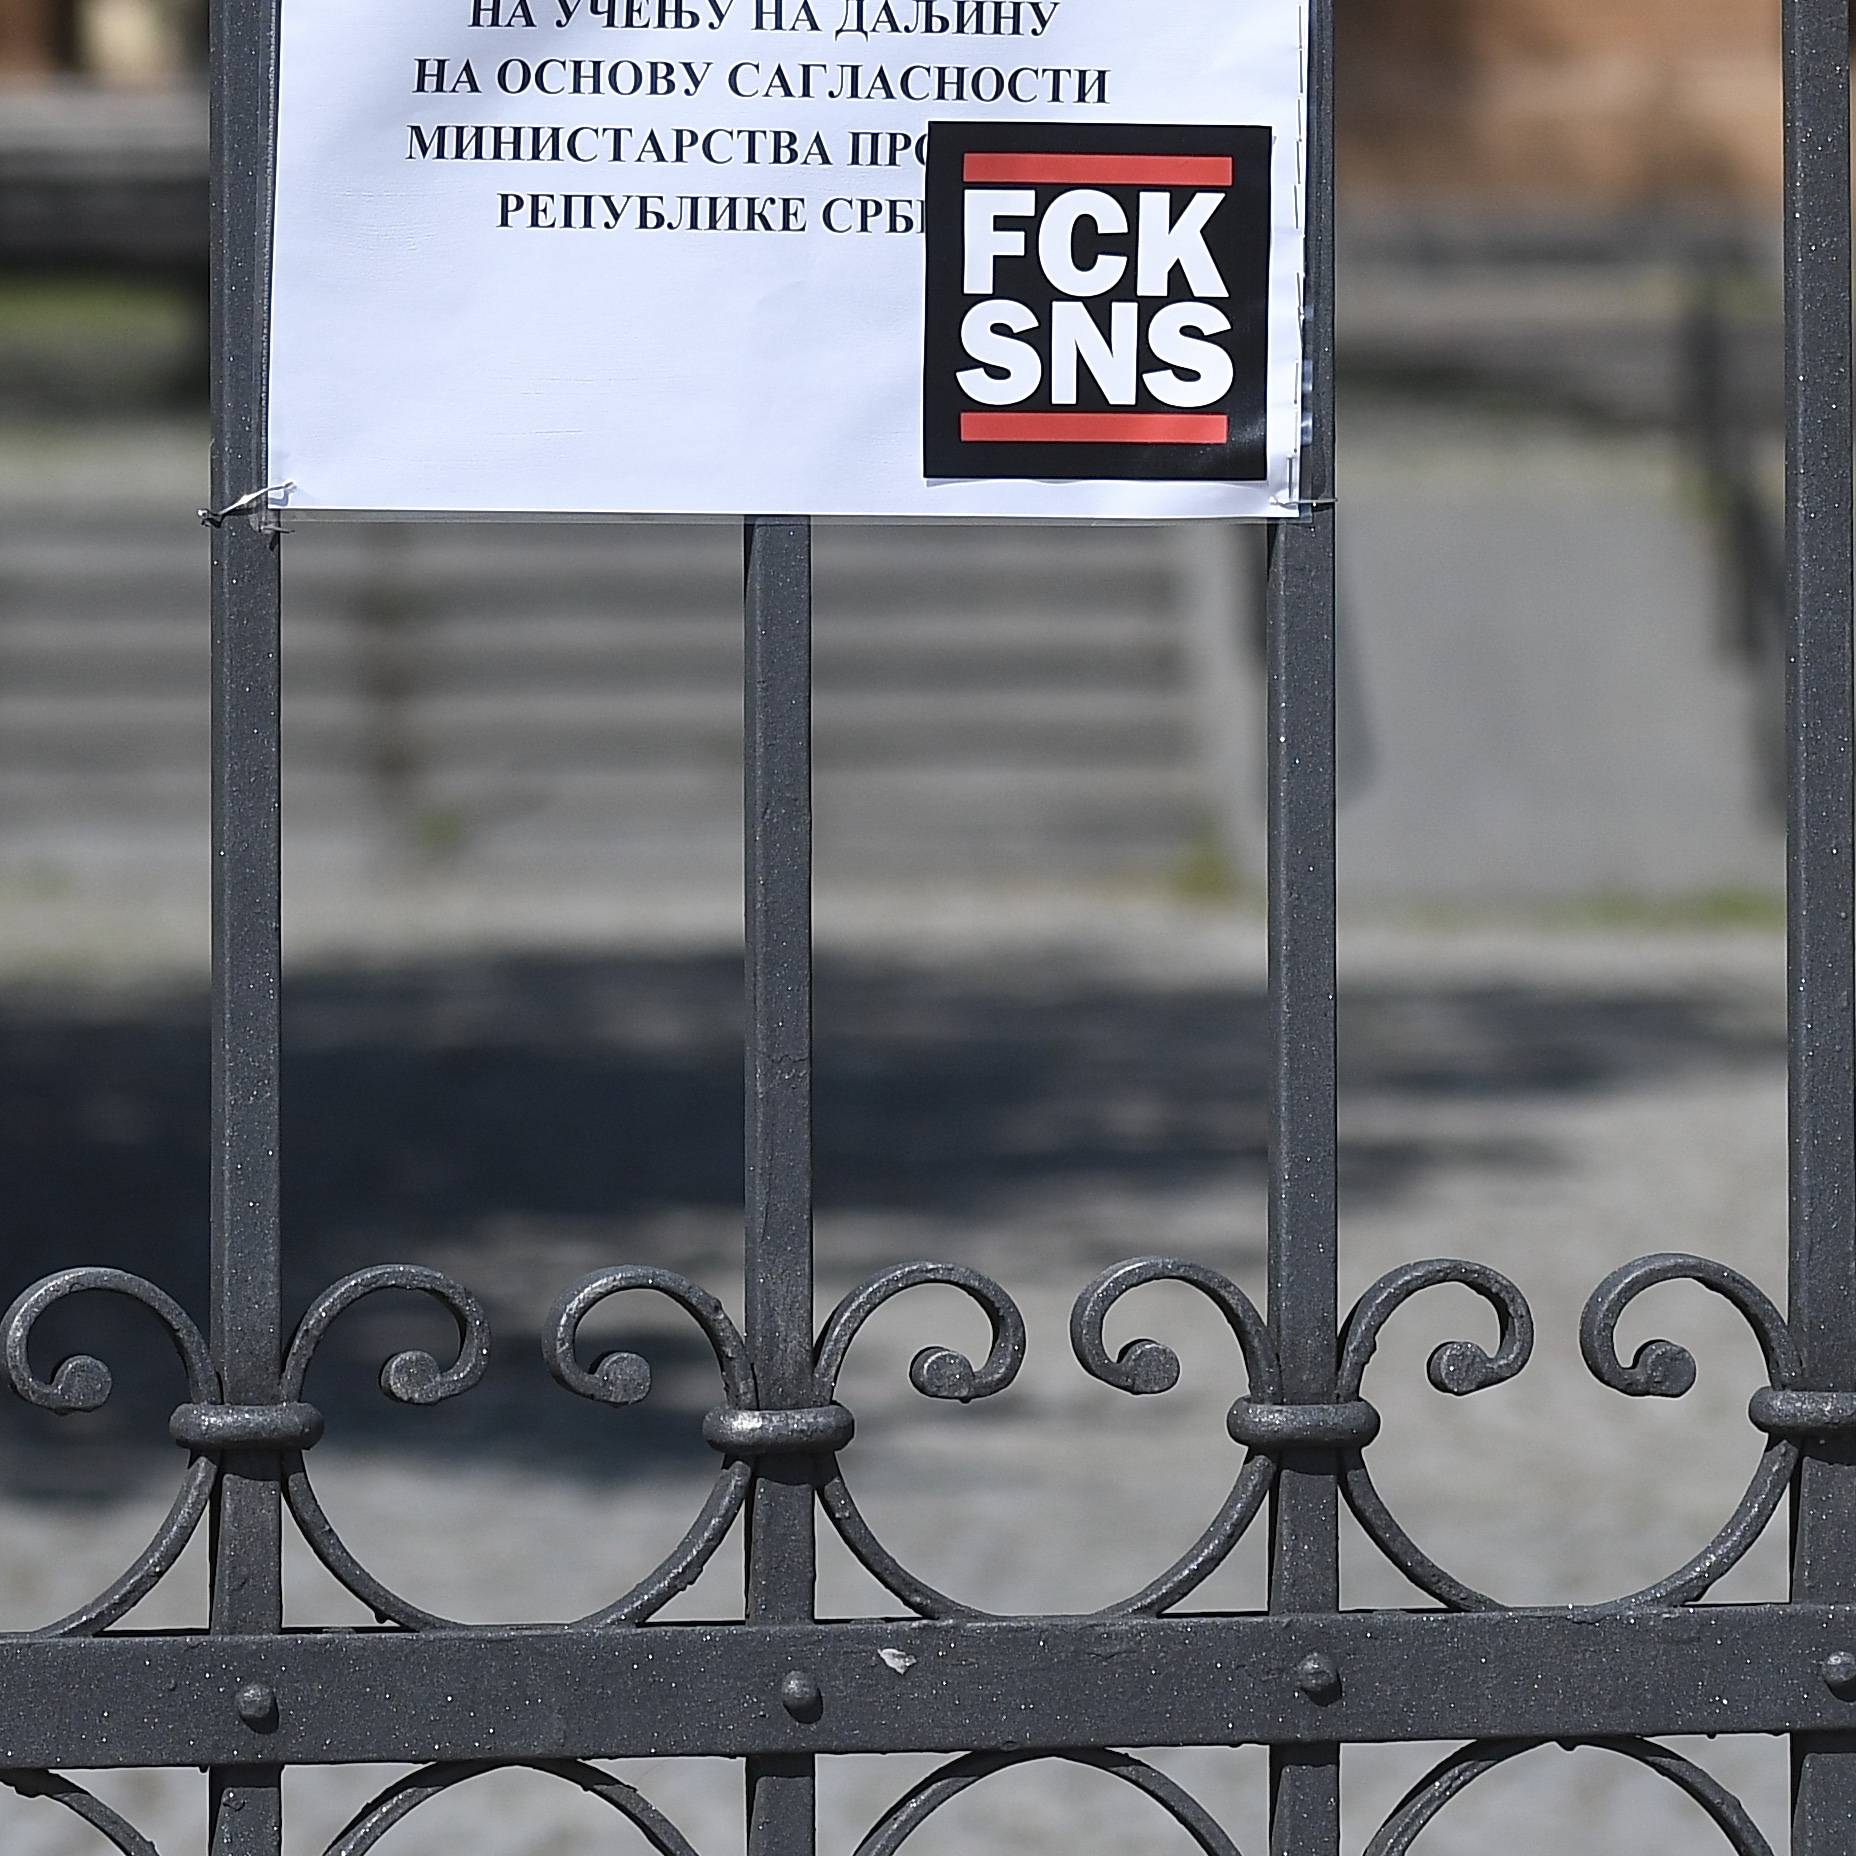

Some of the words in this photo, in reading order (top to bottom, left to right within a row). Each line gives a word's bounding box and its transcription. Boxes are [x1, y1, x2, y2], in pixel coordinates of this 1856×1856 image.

[412, 58, 482, 94] НА
[497, 58, 713, 97] ОСНОВУ
[727, 62, 1111, 104] САГЛАСНОСТИ
[405, 125, 833, 166] МИНИСТАРСТВА
[496, 193, 807, 232] РЕПУБЛИКЕ
[822, 198, 925, 234] СРБ
[963, 189, 1230, 298] FCK
[955, 299, 1234, 408] SNS
